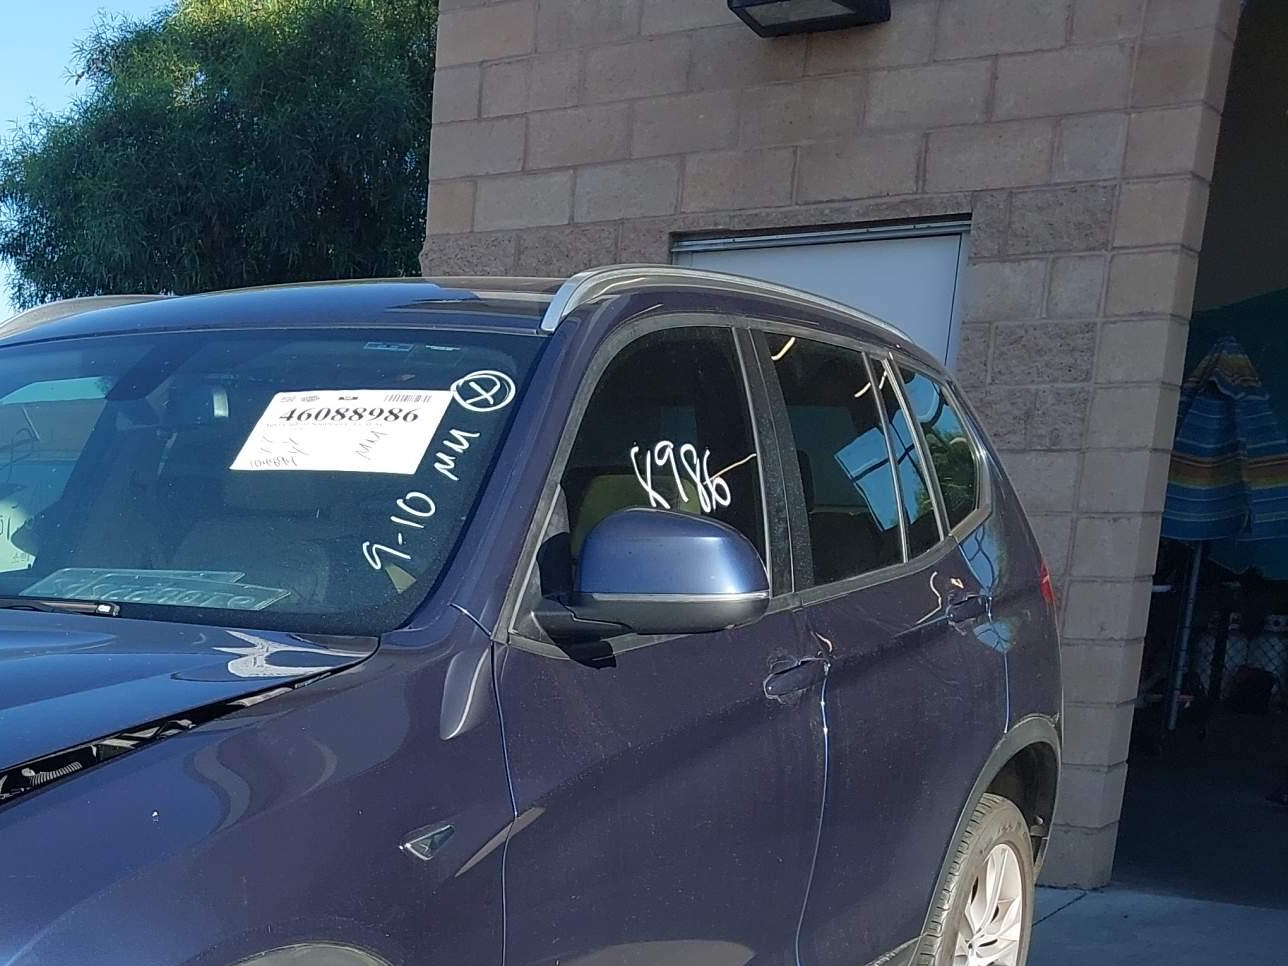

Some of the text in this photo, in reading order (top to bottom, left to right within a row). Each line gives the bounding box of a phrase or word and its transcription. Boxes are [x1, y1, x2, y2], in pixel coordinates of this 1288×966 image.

[278, 406, 421, 424] 46088986
[362, 428, 481, 570] 9-10 MM
